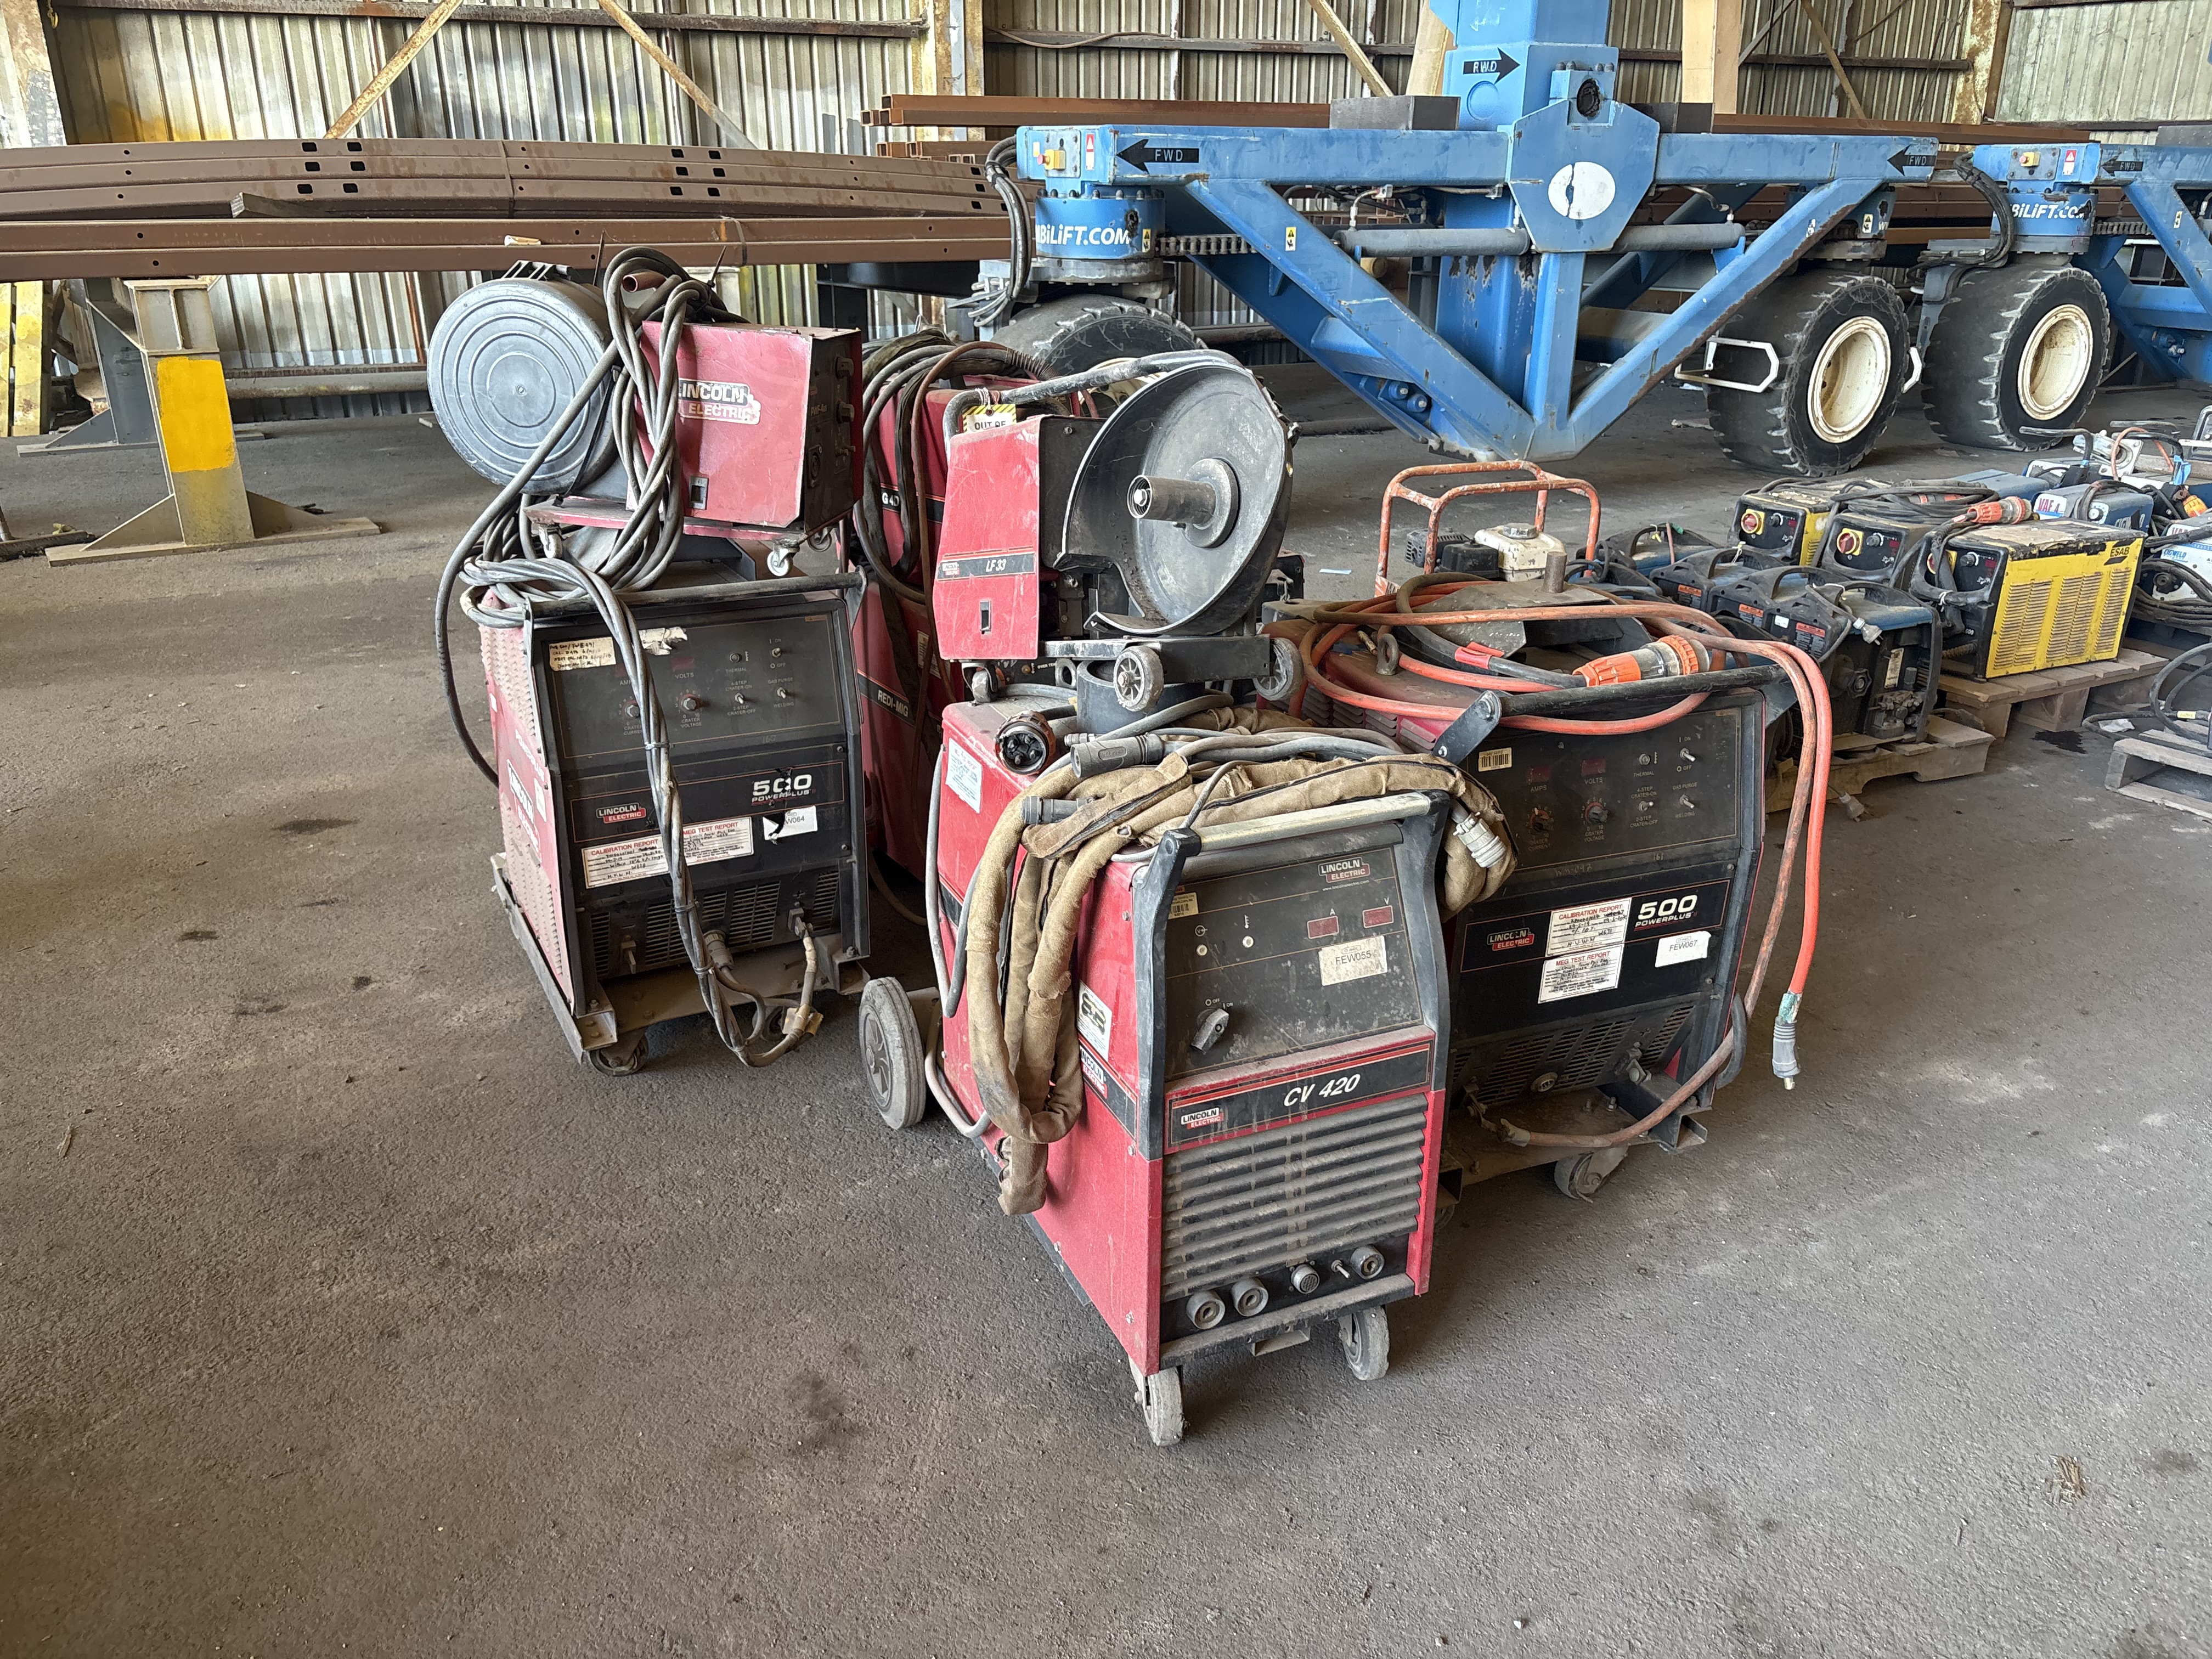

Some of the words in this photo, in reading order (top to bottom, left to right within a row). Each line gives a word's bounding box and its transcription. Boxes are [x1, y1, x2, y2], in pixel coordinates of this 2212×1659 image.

[1473, 61, 1497, 73] RWD
[1155, 149, 1183, 161] FWD
[1909, 156, 1927, 165] FWD
[2119, 162, 2136, 171] FWD
[689, 403, 751, 419] ELECTRIC
[974, 421, 992, 430] OUT
[889, 494, 900, 507] 4D
[2110, 547, 2130, 557] ESAB
[985, 560, 996, 572] LF
[995, 559, 1007, 571] 33
[878, 689, 909, 718] REDI-MIG
[752, 789, 810, 802] POWERPLUS
[599, 805, 637, 816] LINCOLN
[608, 812, 642, 821] ELECTRIC
[714, 822, 739, 831] REPORT
[1630, 820, 1658, 828] CRATER-OFF
[591, 844, 632, 856] CALIBRATION
[634, 839, 659, 848] REPORT
[1321, 859, 1361, 874] LINCOLN
[1331, 868, 1365, 880] ELECTRIC
[1322, 880, 1370, 891] www.lincolnelectric.com
[1384, 896, 1390, 905] V
[1330, 908, 1335, 916] A
[1559, 908, 1598, 920] CALIBRATION
[1599, 904, 1623, 913] REPORT
[1638, 895, 1697, 920] 500
[1635, 912, 1692, 928] POWERPLUS
[1497, 938, 1530, 949] ELECTRIC
[1669, 940, 1698, 952] FEW067
[1335, 950, 1372, 966] FEW055
[1587, 951, 1611, 960] REPORT
[1080, 1048, 1102, 1080] INCOLN
[1083, 1065, 1105, 1095] ELECTRIC
[1284, 1084, 1316, 1107] CV
[1318, 1074, 1361, 1098] 420
[1183, 1109, 1217, 1123] LINCOLN
[1190, 1116, 1221, 1128] ELECTRIC
